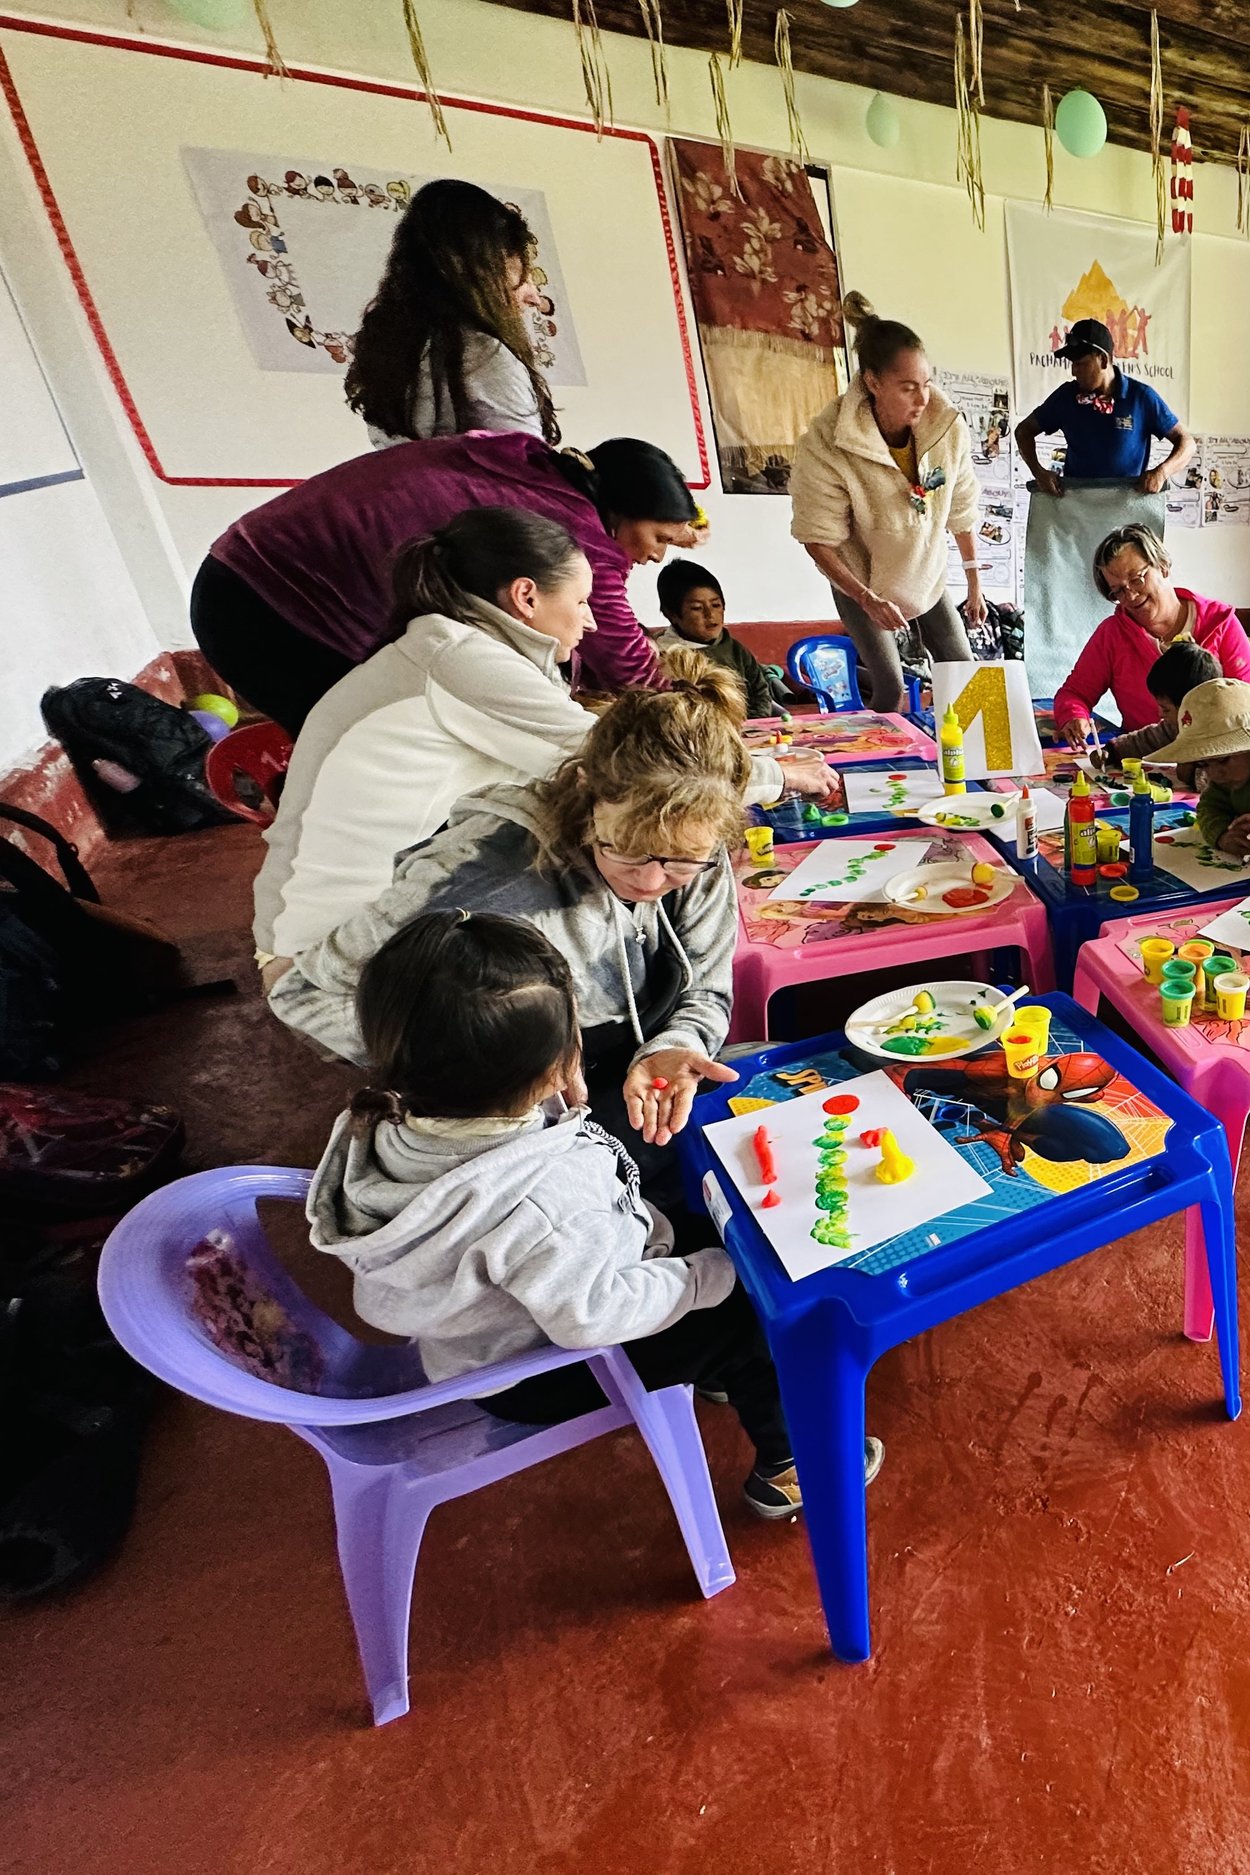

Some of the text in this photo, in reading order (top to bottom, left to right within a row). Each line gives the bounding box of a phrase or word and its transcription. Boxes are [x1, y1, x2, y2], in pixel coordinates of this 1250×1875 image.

[1145, 363, 1174, 379] SCHOOL
[952, 667, 1013, 771] 1
[776, 1068, 828, 1095] SPI
